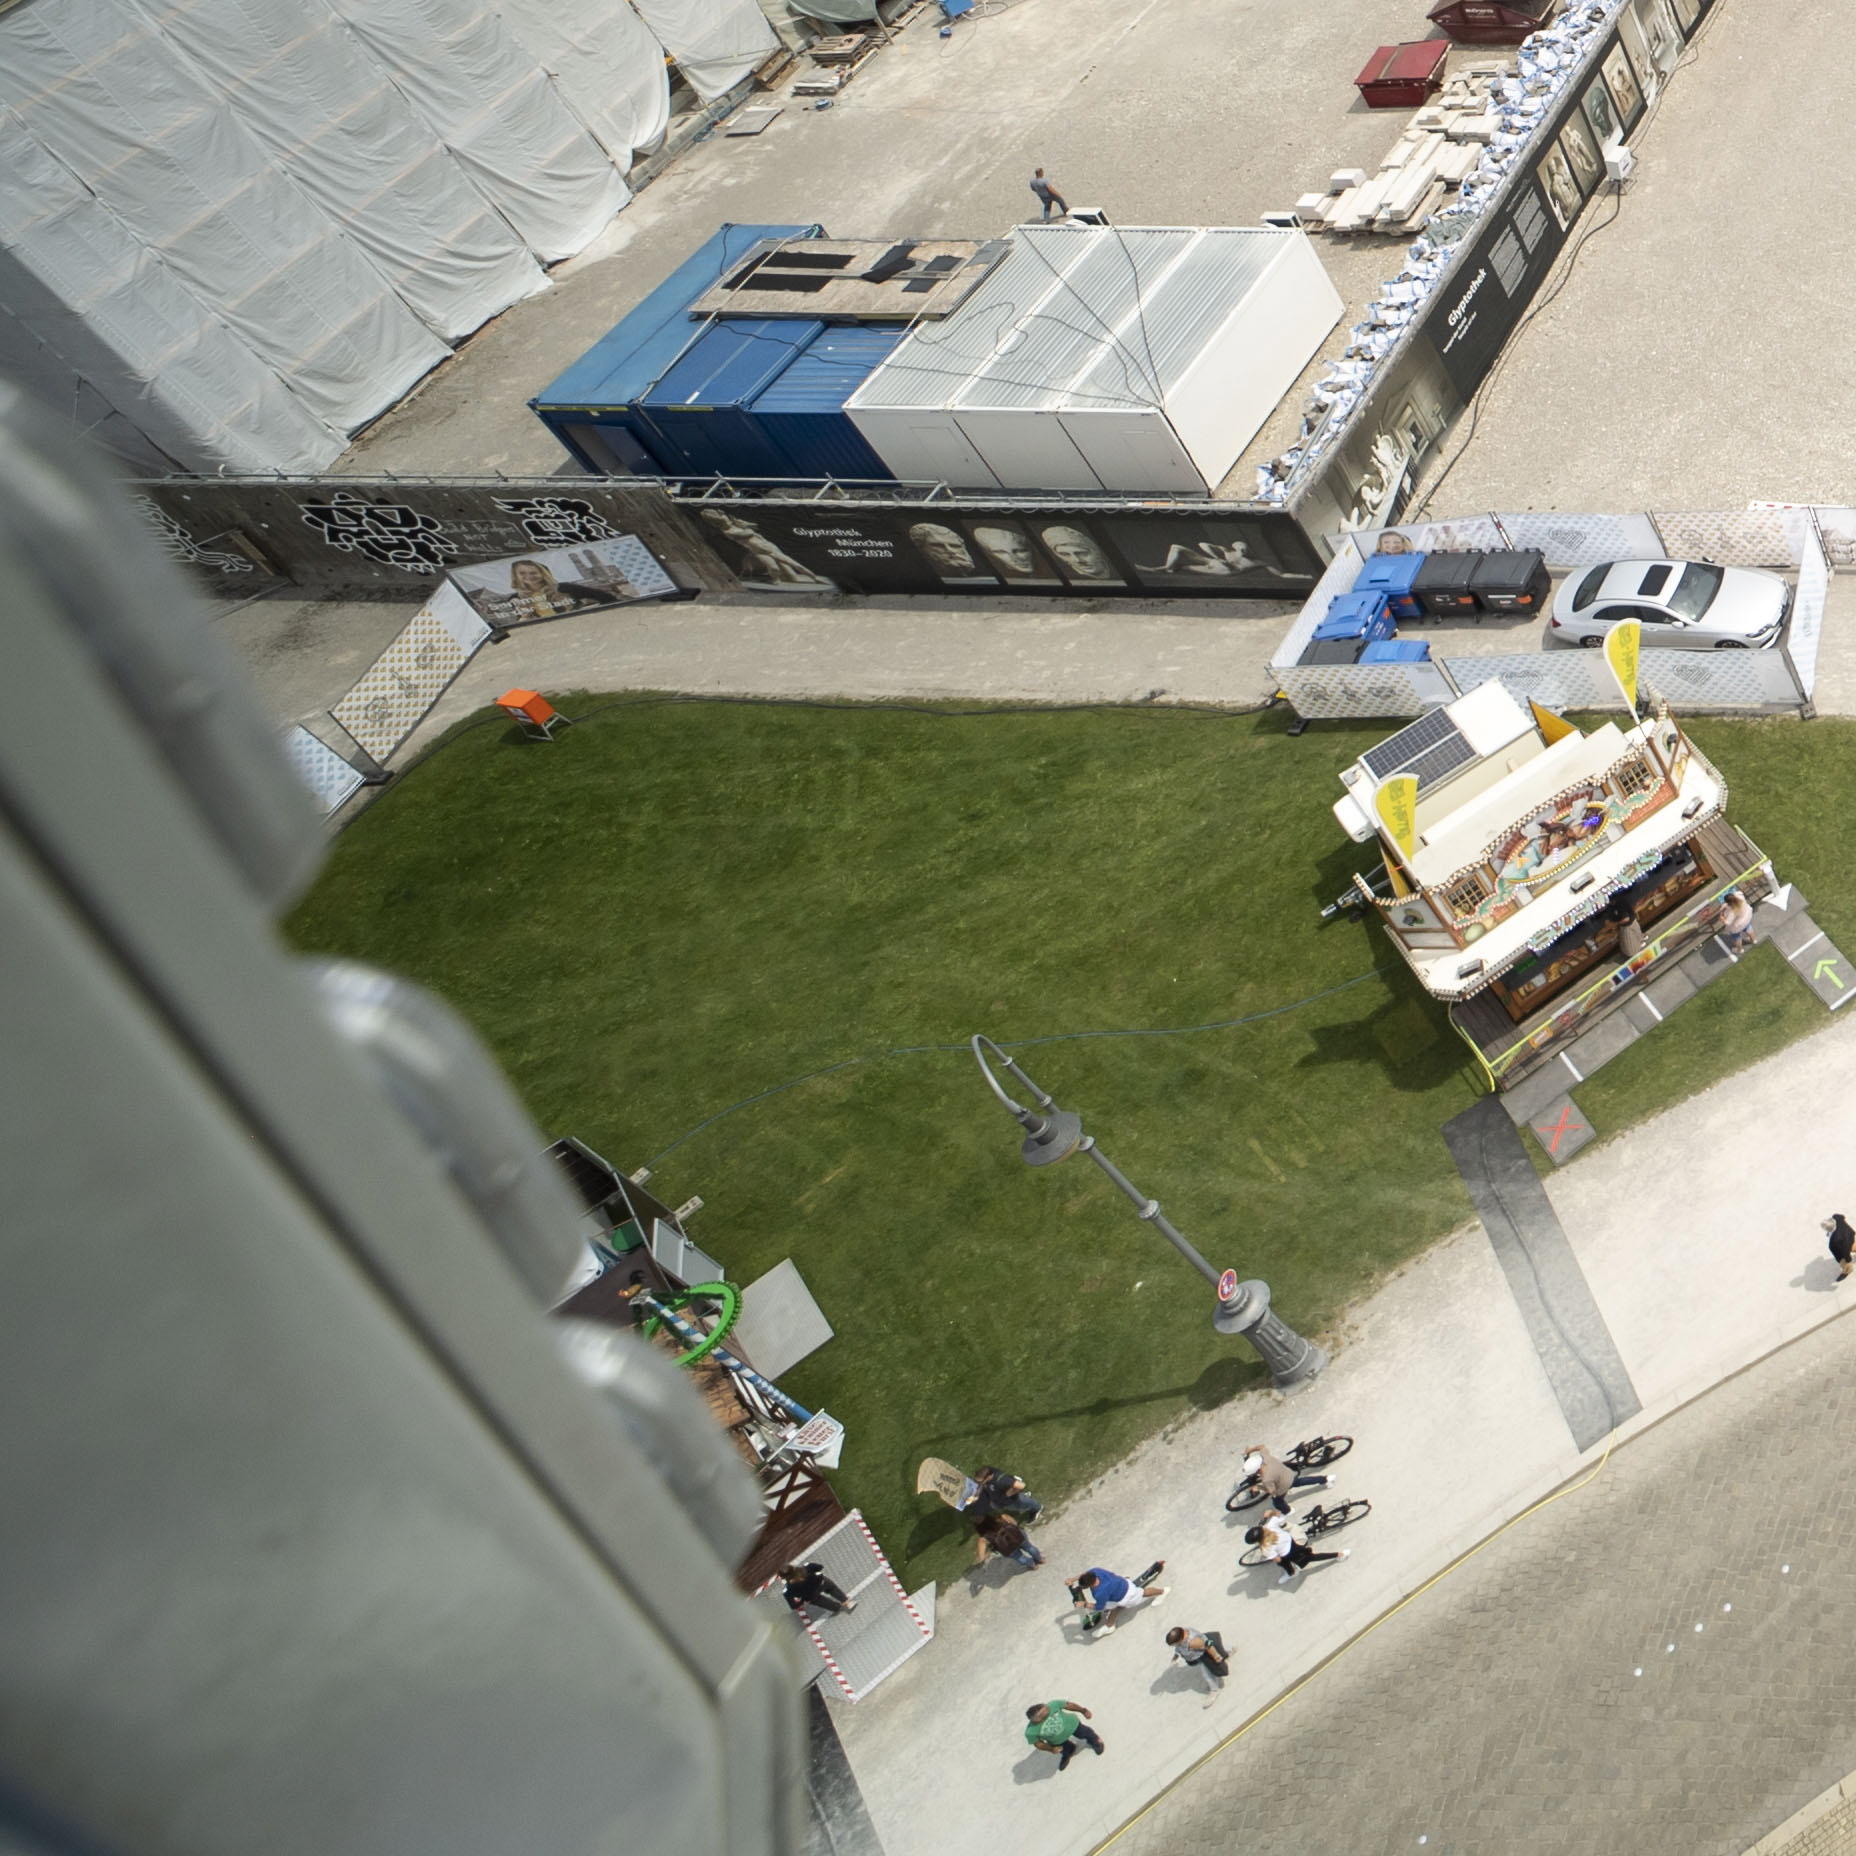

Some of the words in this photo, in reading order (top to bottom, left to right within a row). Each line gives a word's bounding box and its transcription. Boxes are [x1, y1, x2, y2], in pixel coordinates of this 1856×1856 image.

[1447, 267, 1487, 326] Glyptothek
[792, 527, 862, 538] Glyptothek
[834, 538, 894, 547] München
